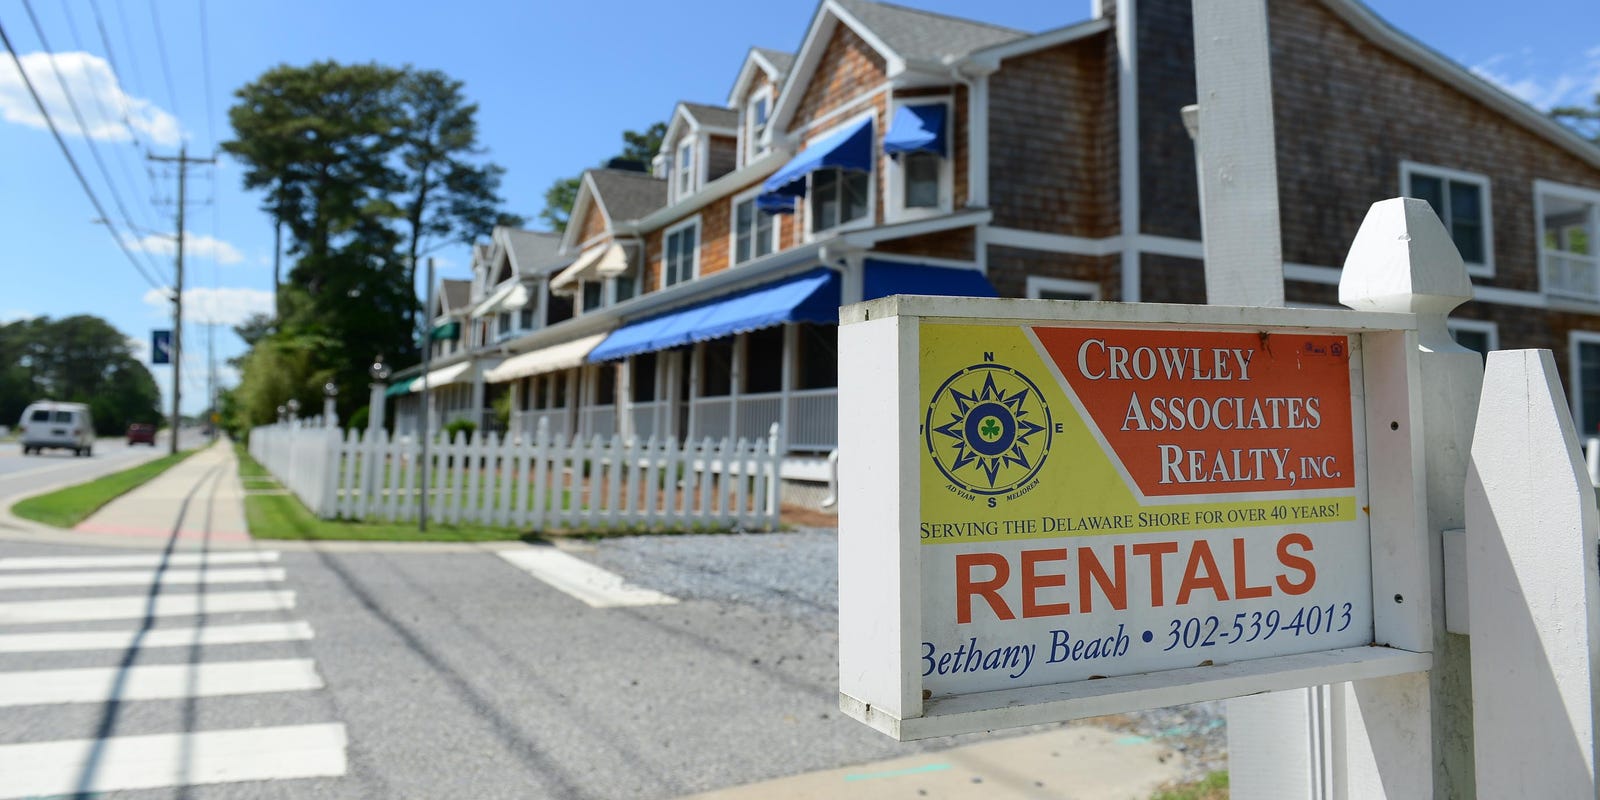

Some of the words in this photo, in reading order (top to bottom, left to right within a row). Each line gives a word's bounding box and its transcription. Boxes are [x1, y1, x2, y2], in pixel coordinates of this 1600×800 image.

[984, 352, 994, 362] N
[1076, 339, 1254, 381] CROWLEY
[1056, 423, 1064, 433] E
[1120, 392, 1321, 432] ASSOCIATES
[1158, 445, 1296, 486] REALTY,
[1300, 455, 1341, 480] INC.
[945, 484, 957, 493] AD
[957, 489, 976, 502] VIAM
[988, 498, 996, 508] S
[1006, 478, 1040, 502] MELIOREM
[920, 522, 999, 539] SERVING
[1003, 519, 1038, 535] THE
[1042, 514, 1134, 532] DELAWARE
[1138, 510, 1191, 528] SHORE
[1195, 510, 1224, 525] FOR
[1228, 508, 1267, 523] OVER
[1270, 506, 1288, 520] 40
[1291, 503, 1340, 519] YEARS!
[955, 532, 1317, 625] RENTALS
[921, 636, 1036, 679] Bethany
[1045, 624, 1130, 665] Beach
[1162, 602, 1354, 652] 302-539-4013
